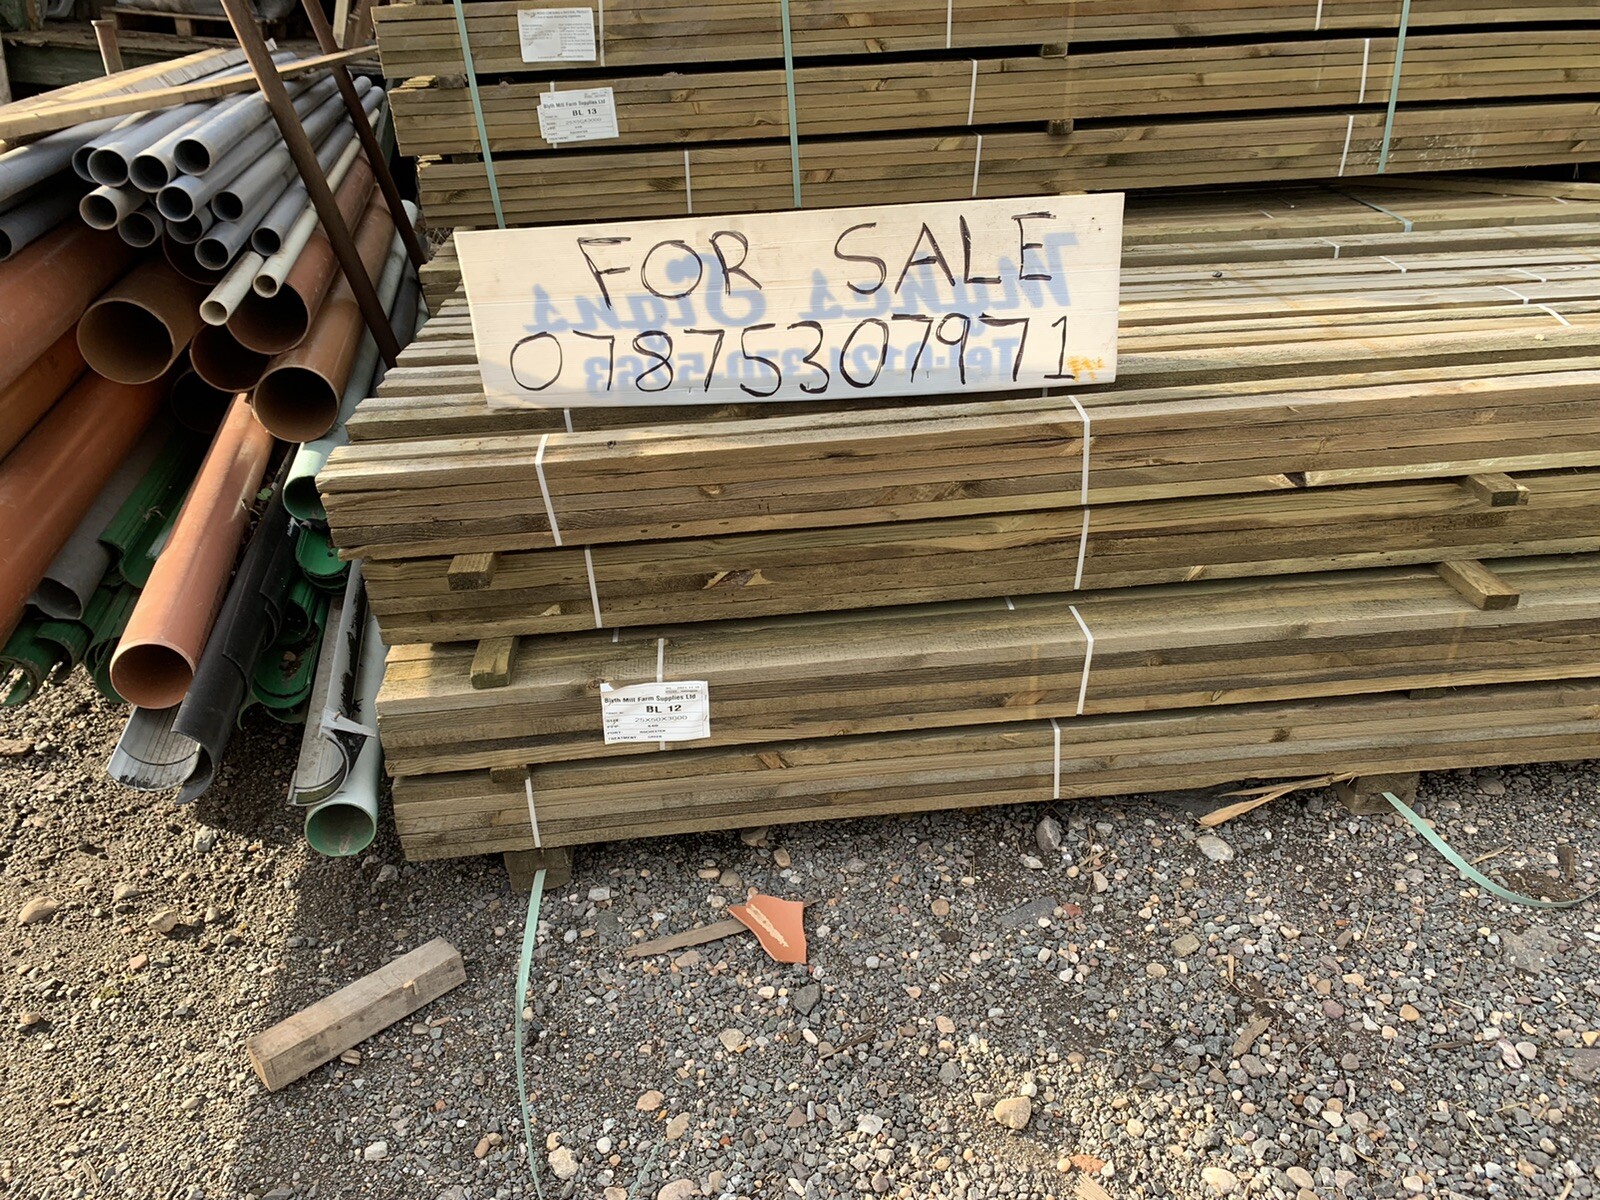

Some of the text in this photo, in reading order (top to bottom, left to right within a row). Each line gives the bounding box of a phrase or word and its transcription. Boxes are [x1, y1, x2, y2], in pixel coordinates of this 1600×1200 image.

[577, 211, 1057, 311] FOR SALE
[510, 312, 1075, 398] 07875307971
[646, 704, 682, 714] BL 12
[656, 694, 684, 702] Supplies
